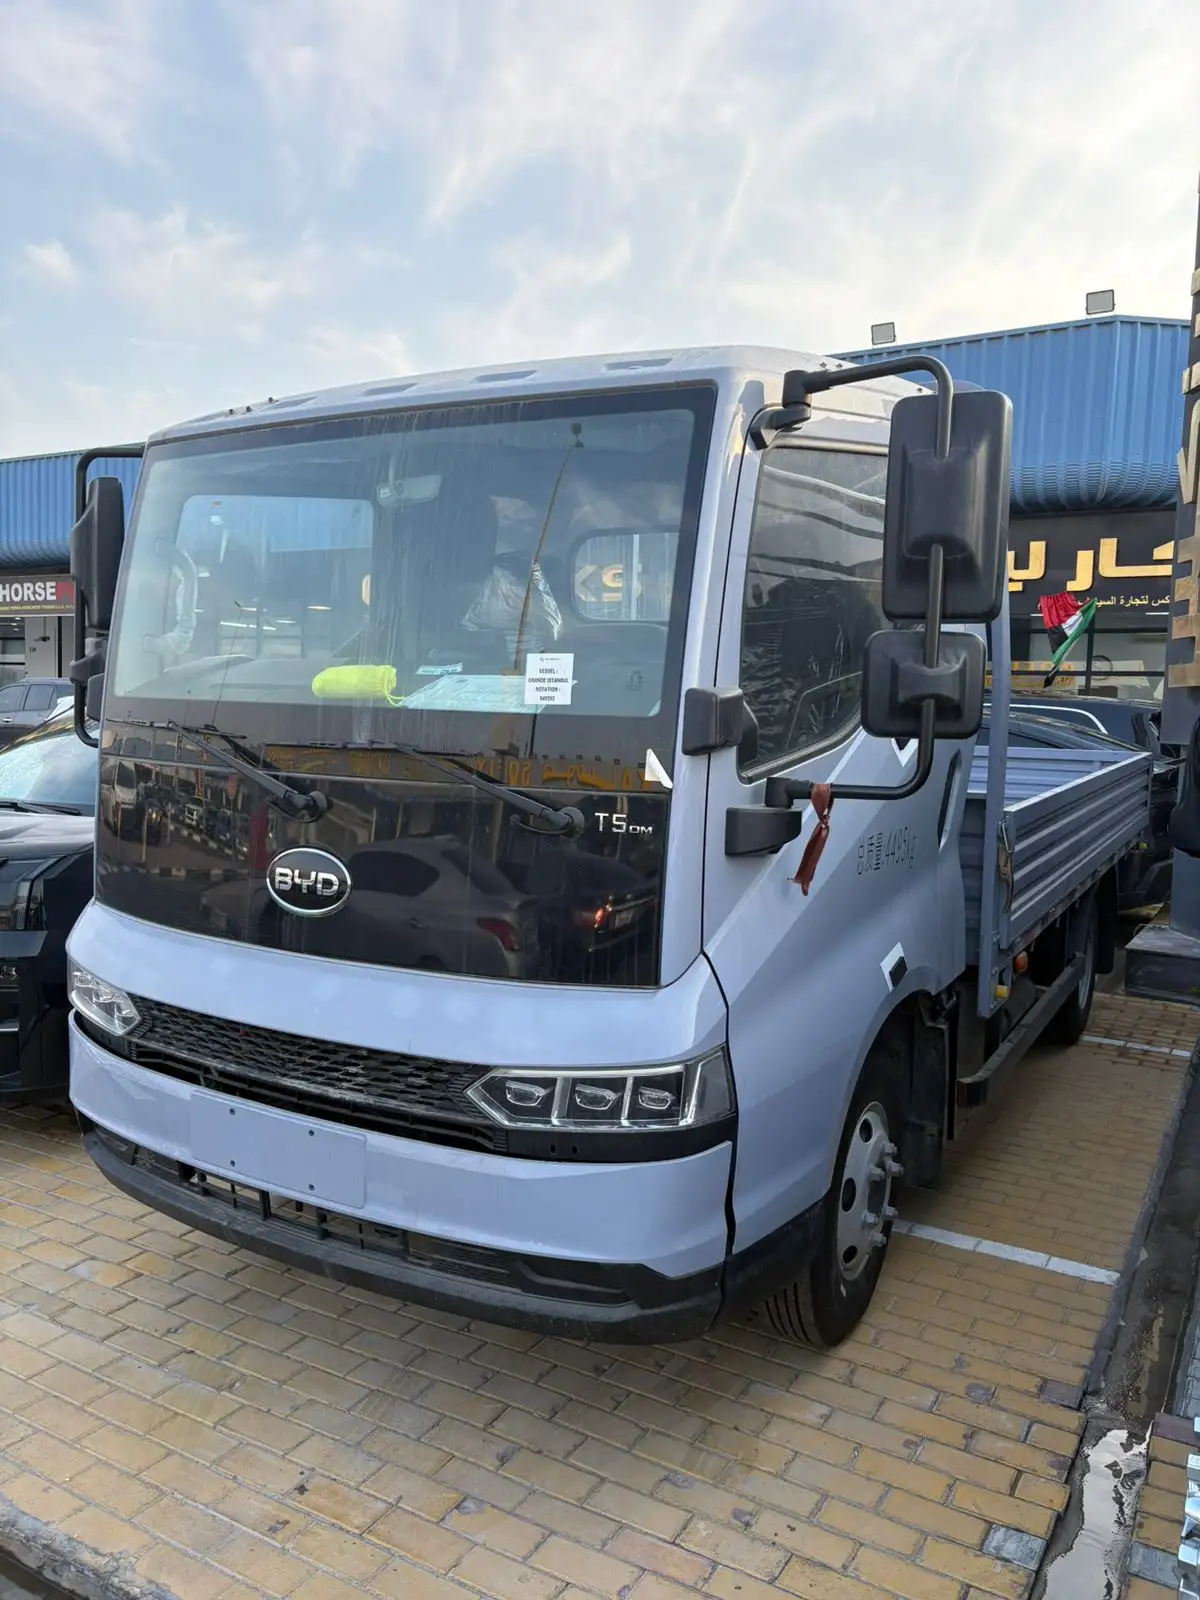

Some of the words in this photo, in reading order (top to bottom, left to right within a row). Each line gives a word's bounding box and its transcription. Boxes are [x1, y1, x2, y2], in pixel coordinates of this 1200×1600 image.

[0, 581, 57, 602] HORSE
[1120, 595, 1149, 608] لتجارة
[275, 867, 339, 896] BYD
